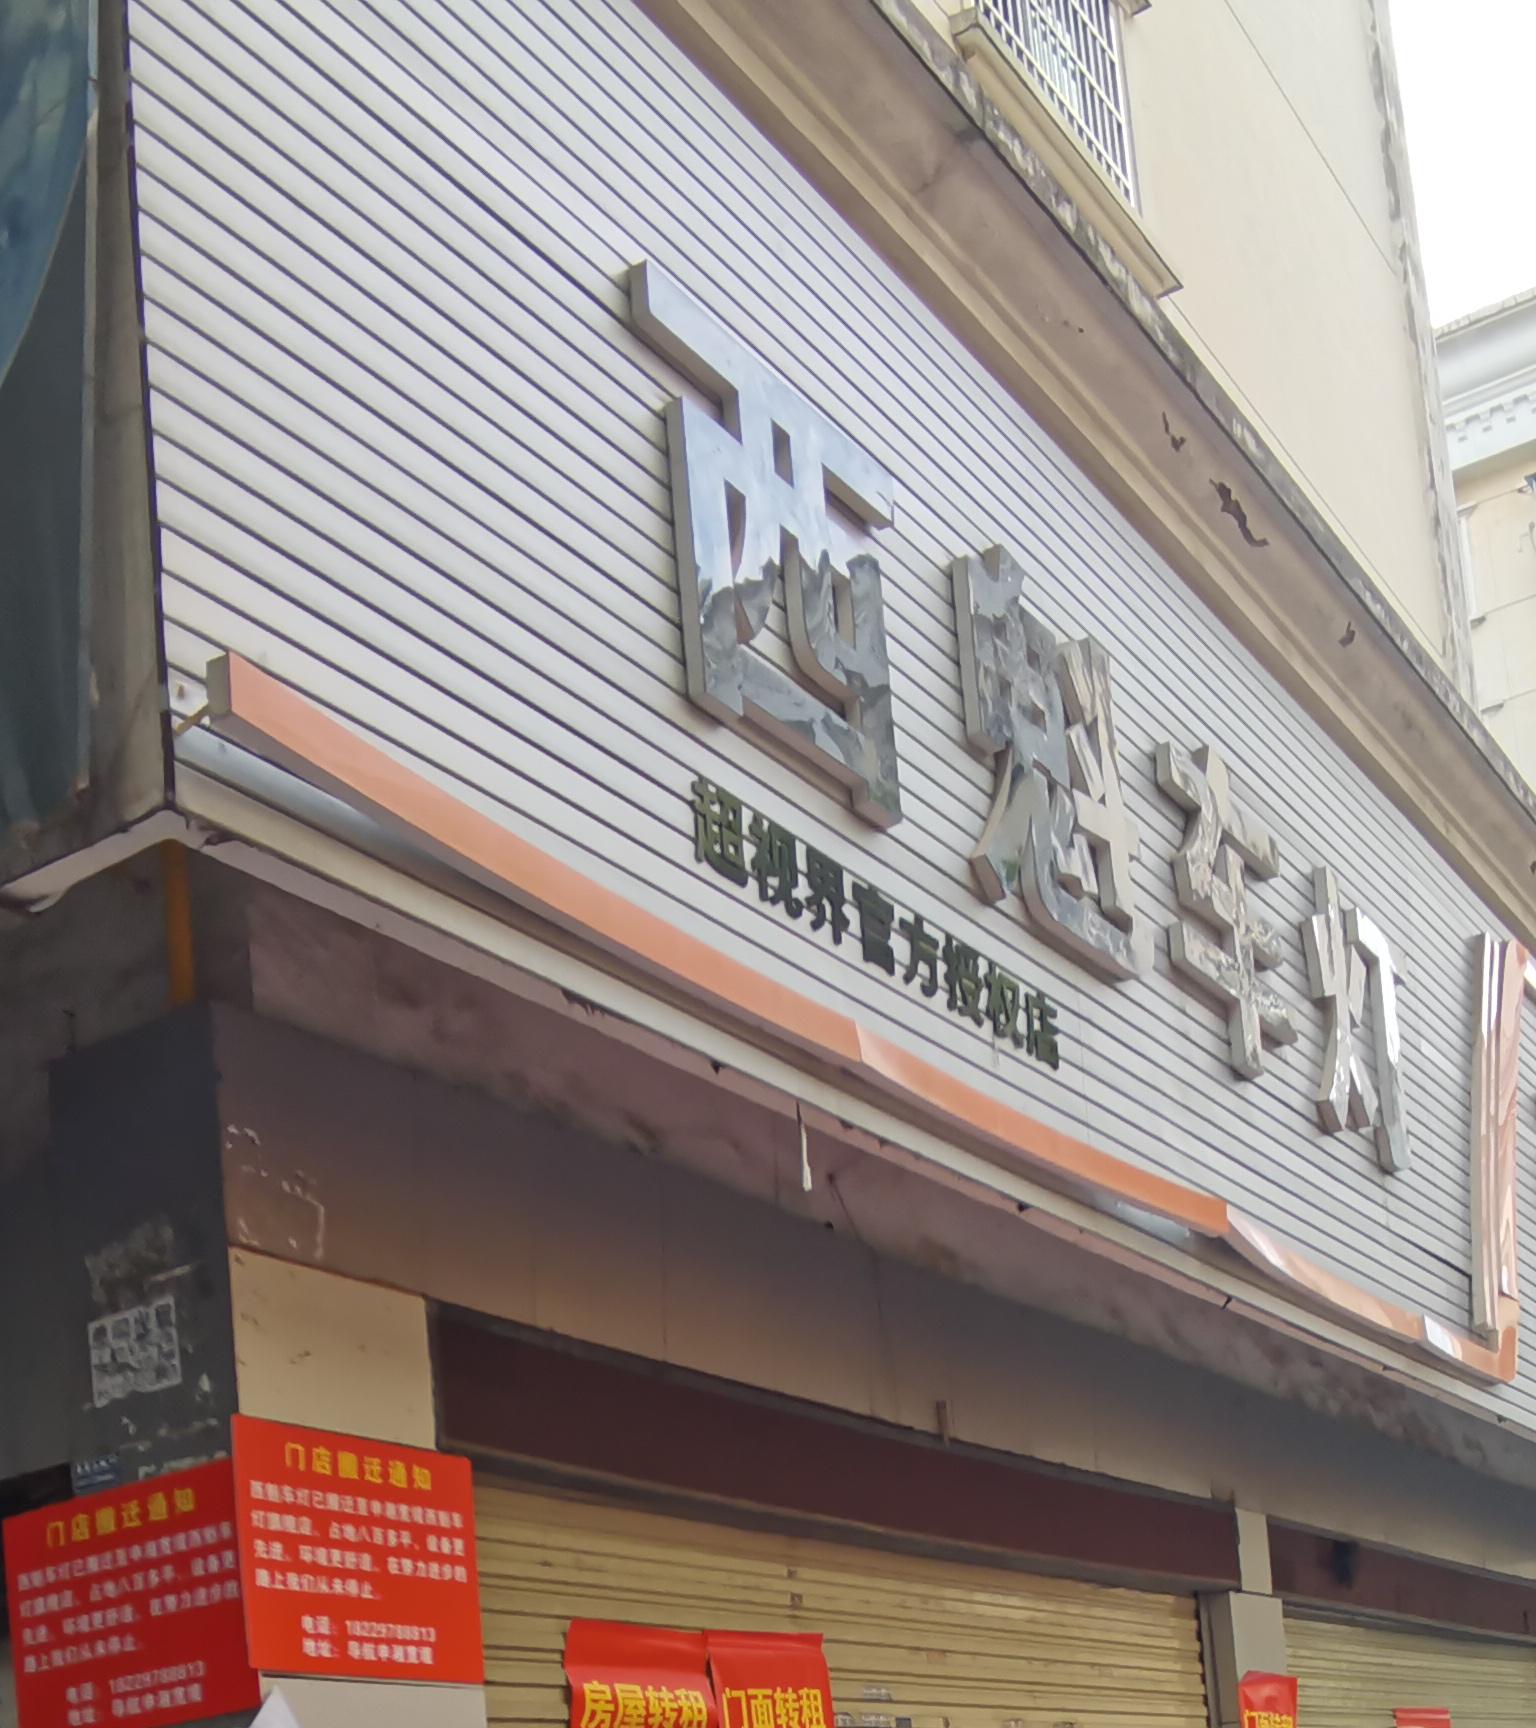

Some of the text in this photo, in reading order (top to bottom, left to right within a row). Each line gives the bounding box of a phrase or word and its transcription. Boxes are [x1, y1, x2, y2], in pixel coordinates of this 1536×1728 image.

[626, 259, 1413, 1173] 西魁车灯
[692, 774, 1061, 1071] 超视界官方授权店
